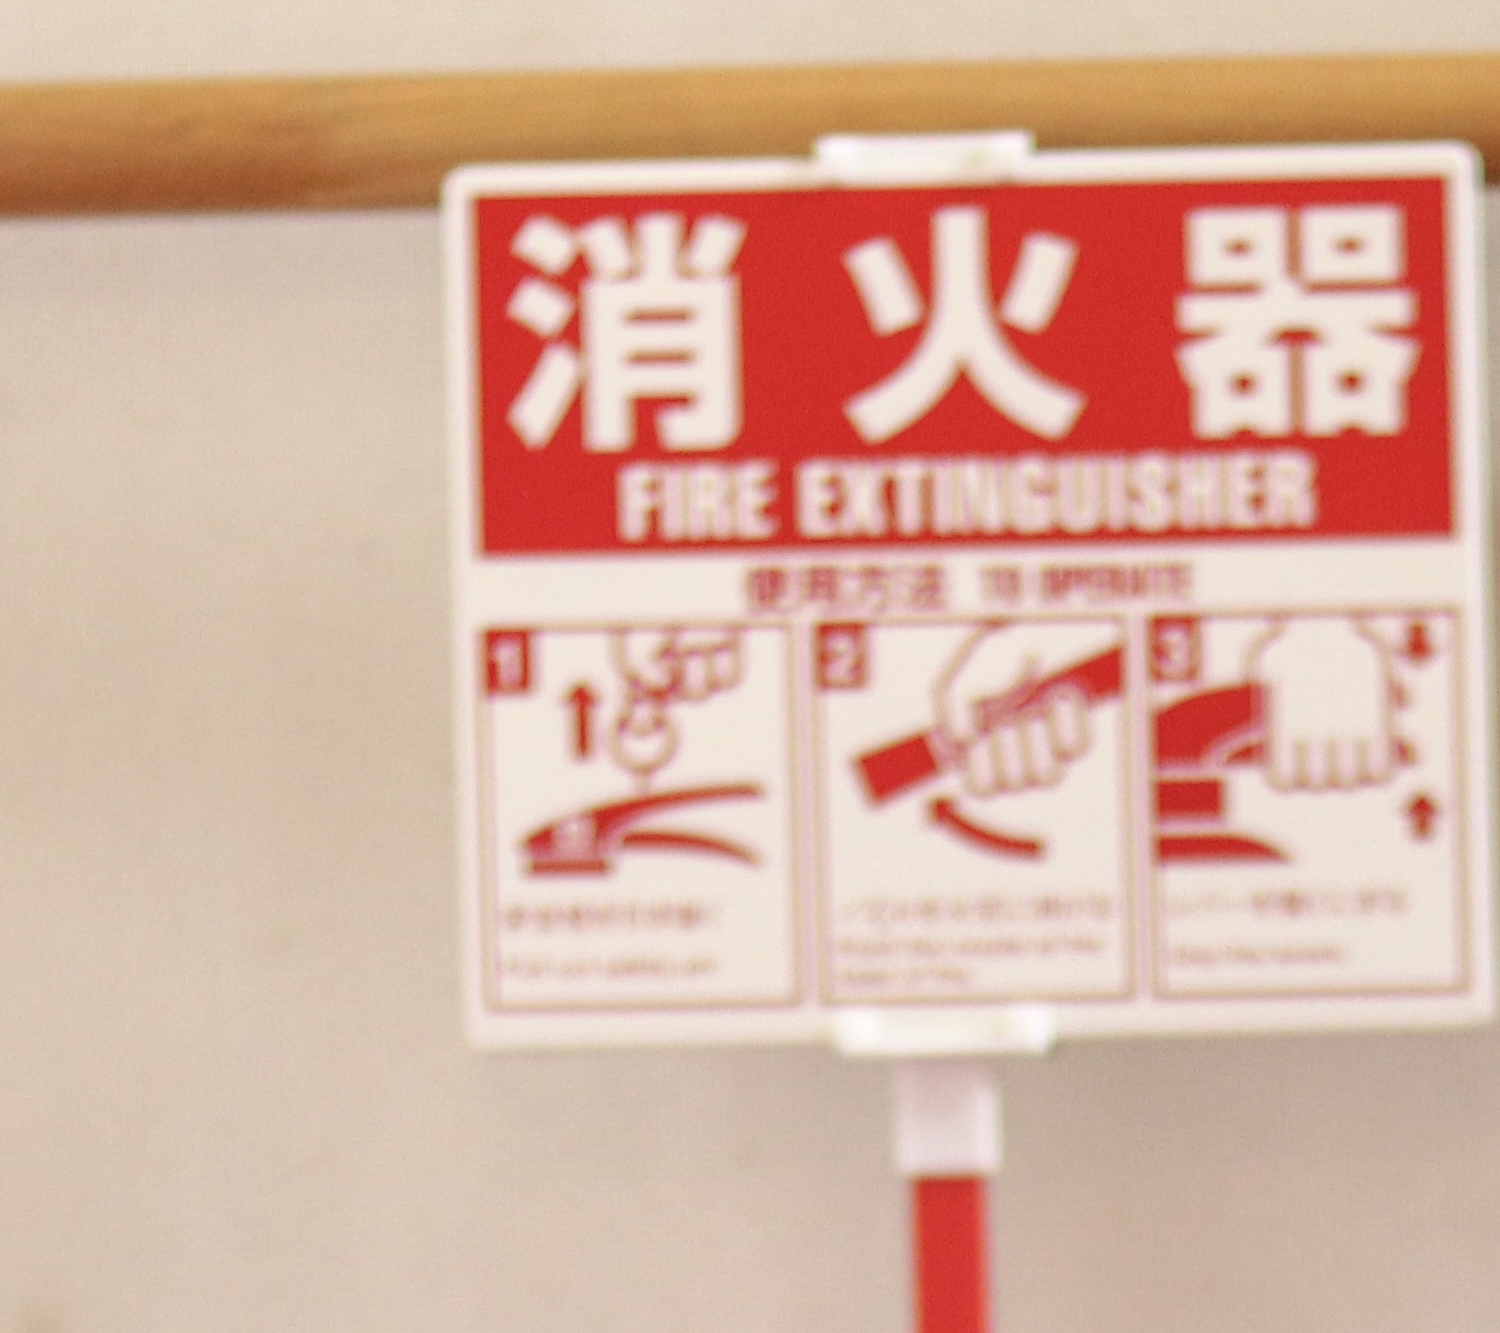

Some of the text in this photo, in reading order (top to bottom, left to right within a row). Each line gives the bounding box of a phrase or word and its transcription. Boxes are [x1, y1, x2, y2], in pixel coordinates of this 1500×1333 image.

[506, 206, 1422, 453] 消火器
[617, 450, 1316, 543] FIRE EXTINGUISHER
[746, 563, 946, 610] 使用方法
[981, 563, 1021, 603] TO
